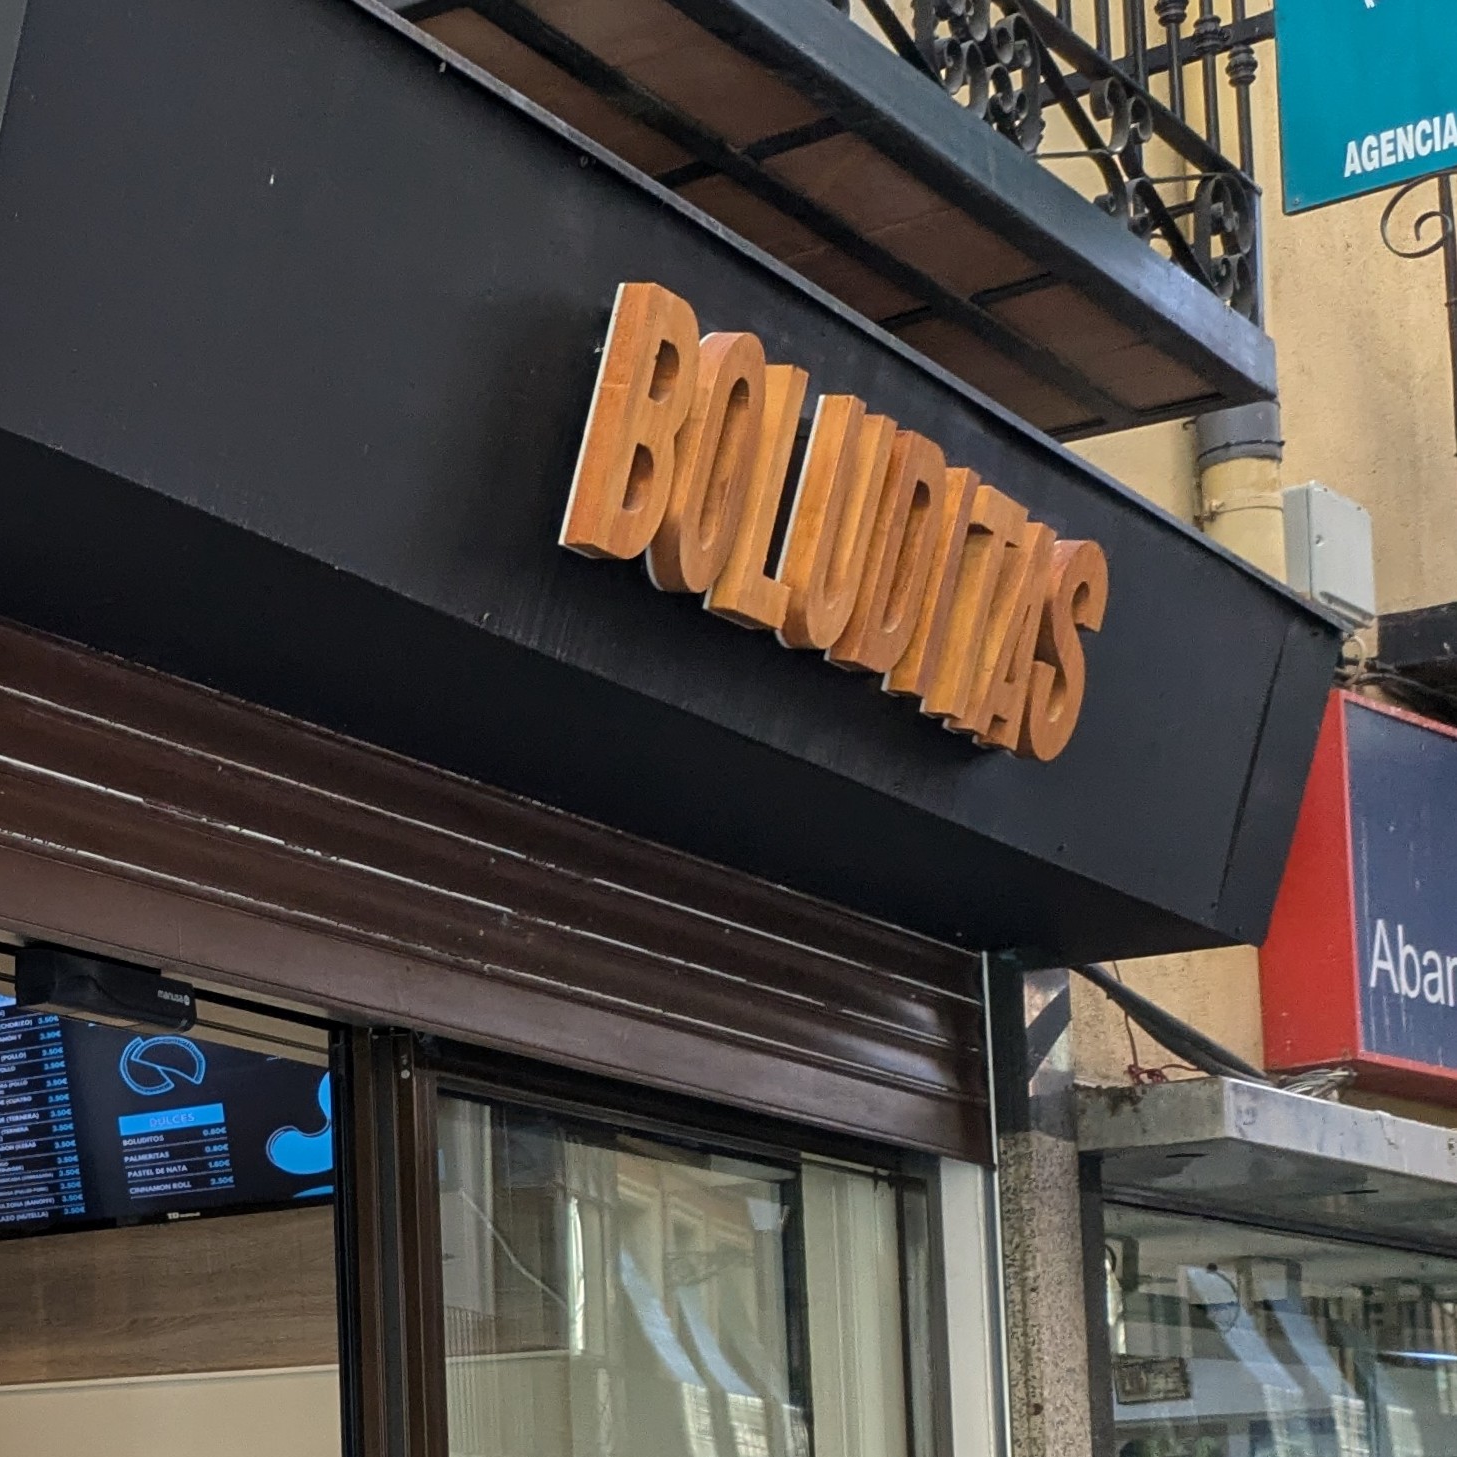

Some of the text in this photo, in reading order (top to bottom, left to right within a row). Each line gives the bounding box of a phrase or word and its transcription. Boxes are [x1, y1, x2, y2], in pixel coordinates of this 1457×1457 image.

[1344, 112, 1457, 178] AGENCIA
[558, 282, 1108, 762] BOLUDITAS
[149, 1112, 195, 1127] DULCES
